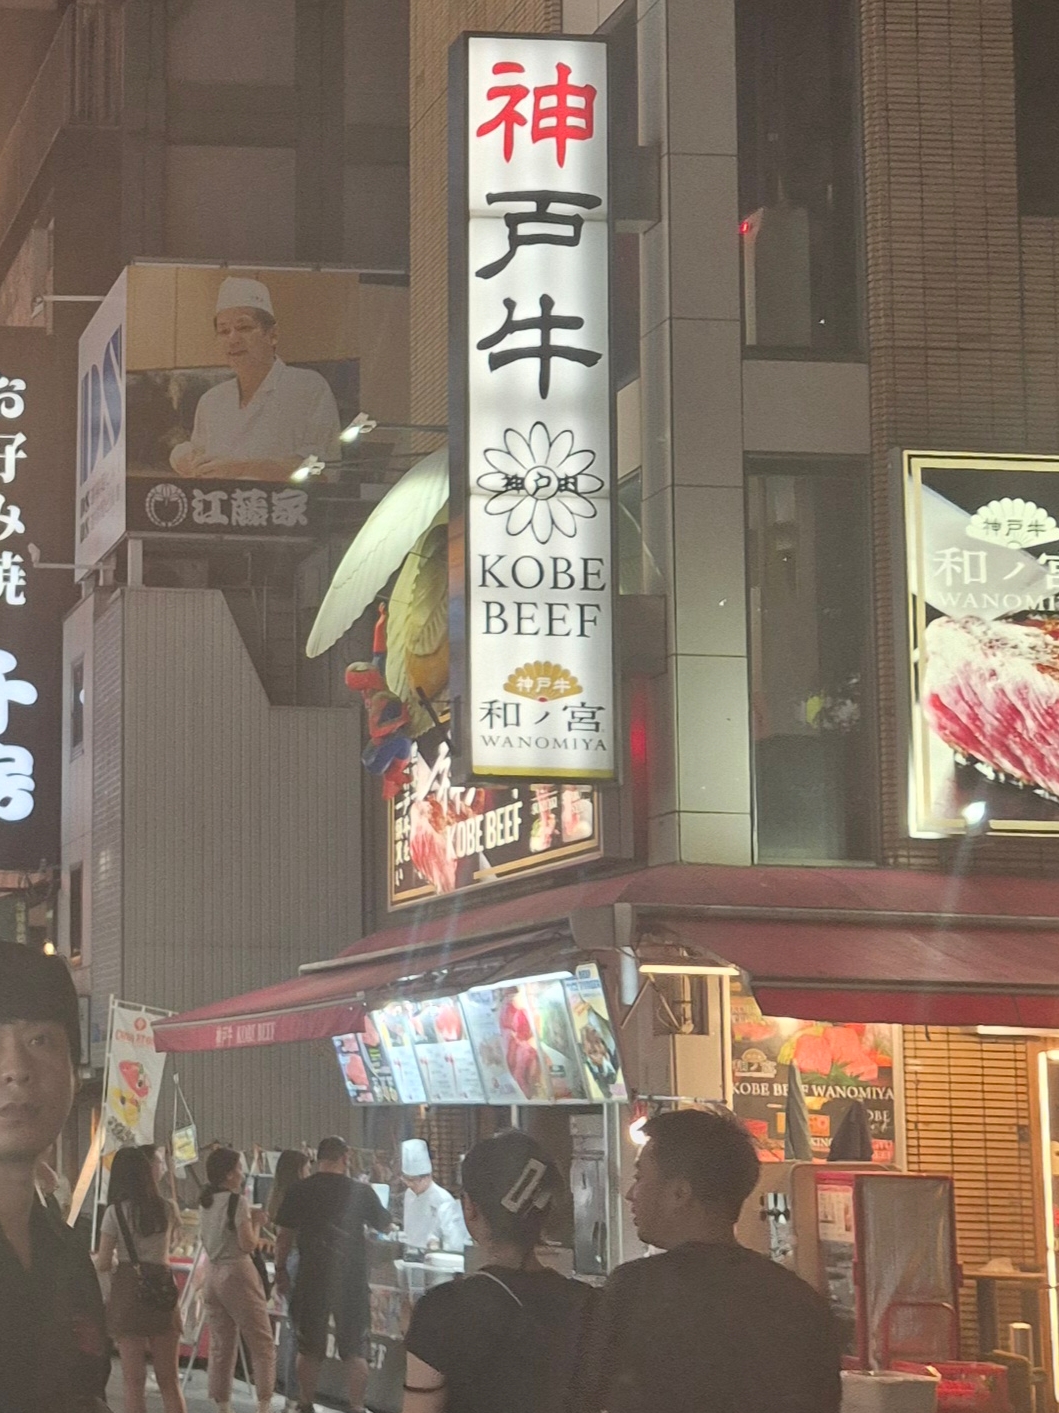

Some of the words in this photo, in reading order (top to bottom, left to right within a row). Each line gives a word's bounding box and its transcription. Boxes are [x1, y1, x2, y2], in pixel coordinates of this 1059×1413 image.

[475, 61, 603, 400] 神戸牛
[983, 518, 1047, 537] 神戸牛
[478, 554, 606, 591] KOBE
[482, 600, 602, 638] BEEF
[515, 676, 572, 694] 神戸牛
[479, 699, 606, 733] 和ノ宮
[481, 735, 607, 751] WANOMIYA
[447, 815, 484, 859] KOBE
[484, 801, 523, 849] BEEF
[732, 1082, 769, 1096] KOBE
[811, 1084, 894, 1100] WANOMIYA
